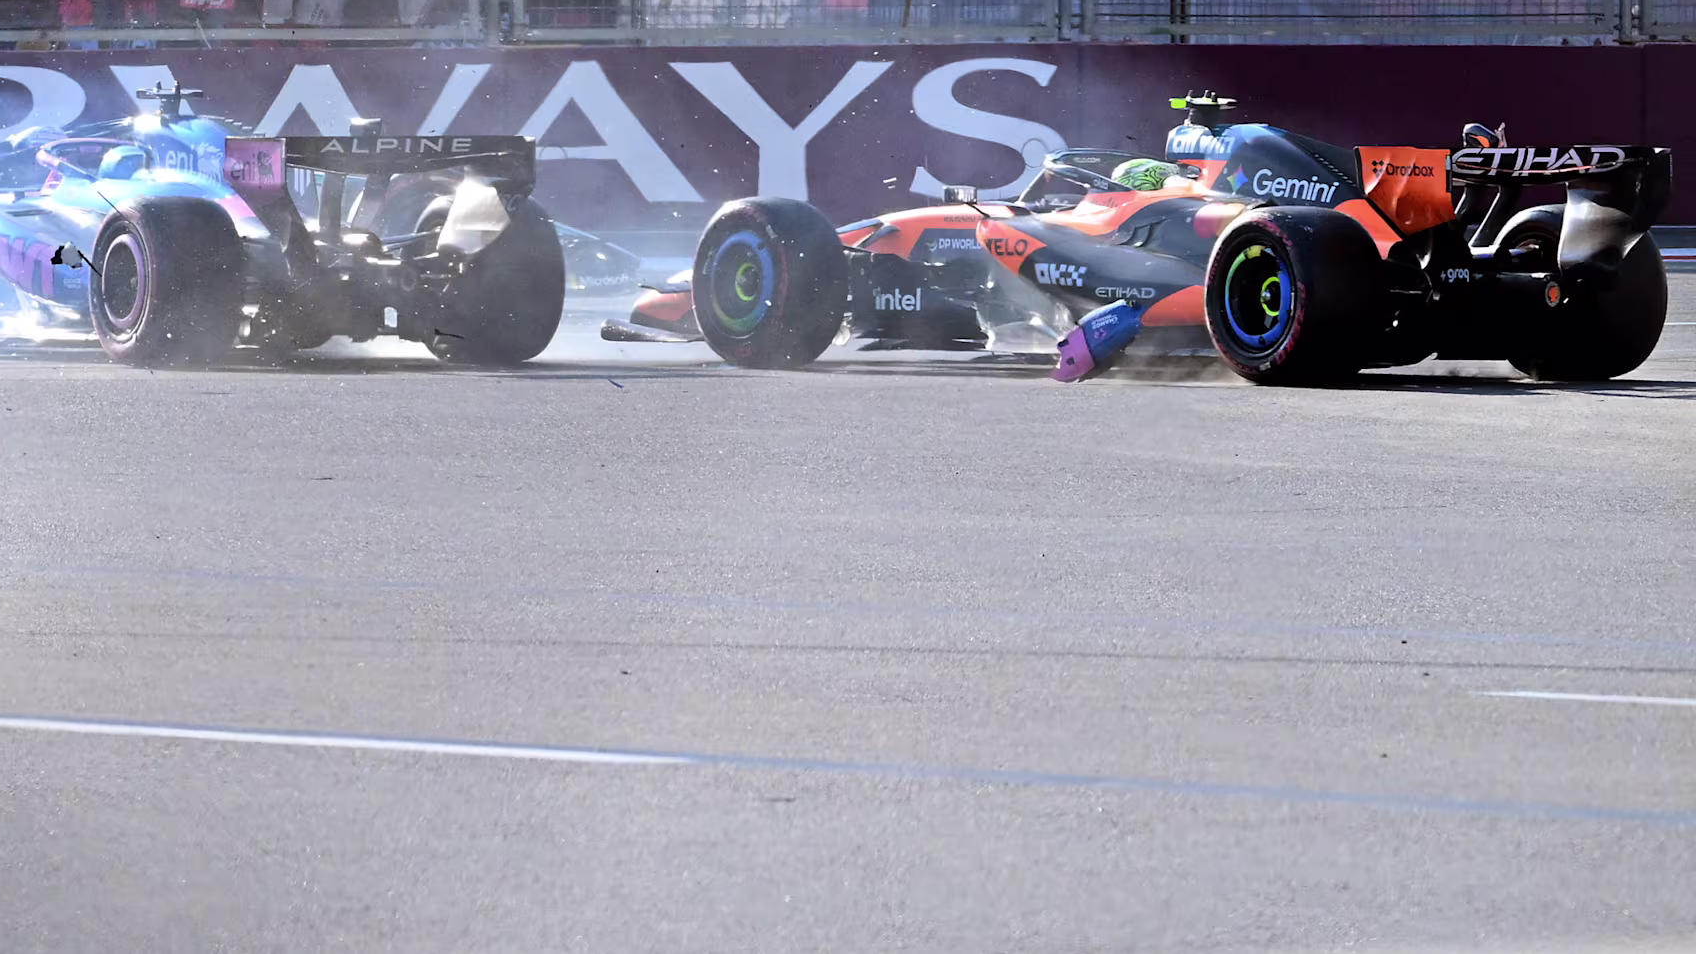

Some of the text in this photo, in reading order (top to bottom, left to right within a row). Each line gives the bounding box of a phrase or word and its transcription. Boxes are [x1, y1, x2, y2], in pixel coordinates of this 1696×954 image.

[320, 138, 472, 153] ALPINE
[1386, 163, 1434, 177] Dropbox
[1451, 147, 1626, 177] ETIHAD
[1254, 169, 1340, 203] Gemini
[939, 238, 983, 249] DP WORLD
[986, 238, 1029, 256] VELO
[1034, 263, 1088, 287] OKX
[1447, 268, 1470, 283] groq
[873, 287, 922, 311] intel
[1095, 286, 1156, 298] ETIHAD
